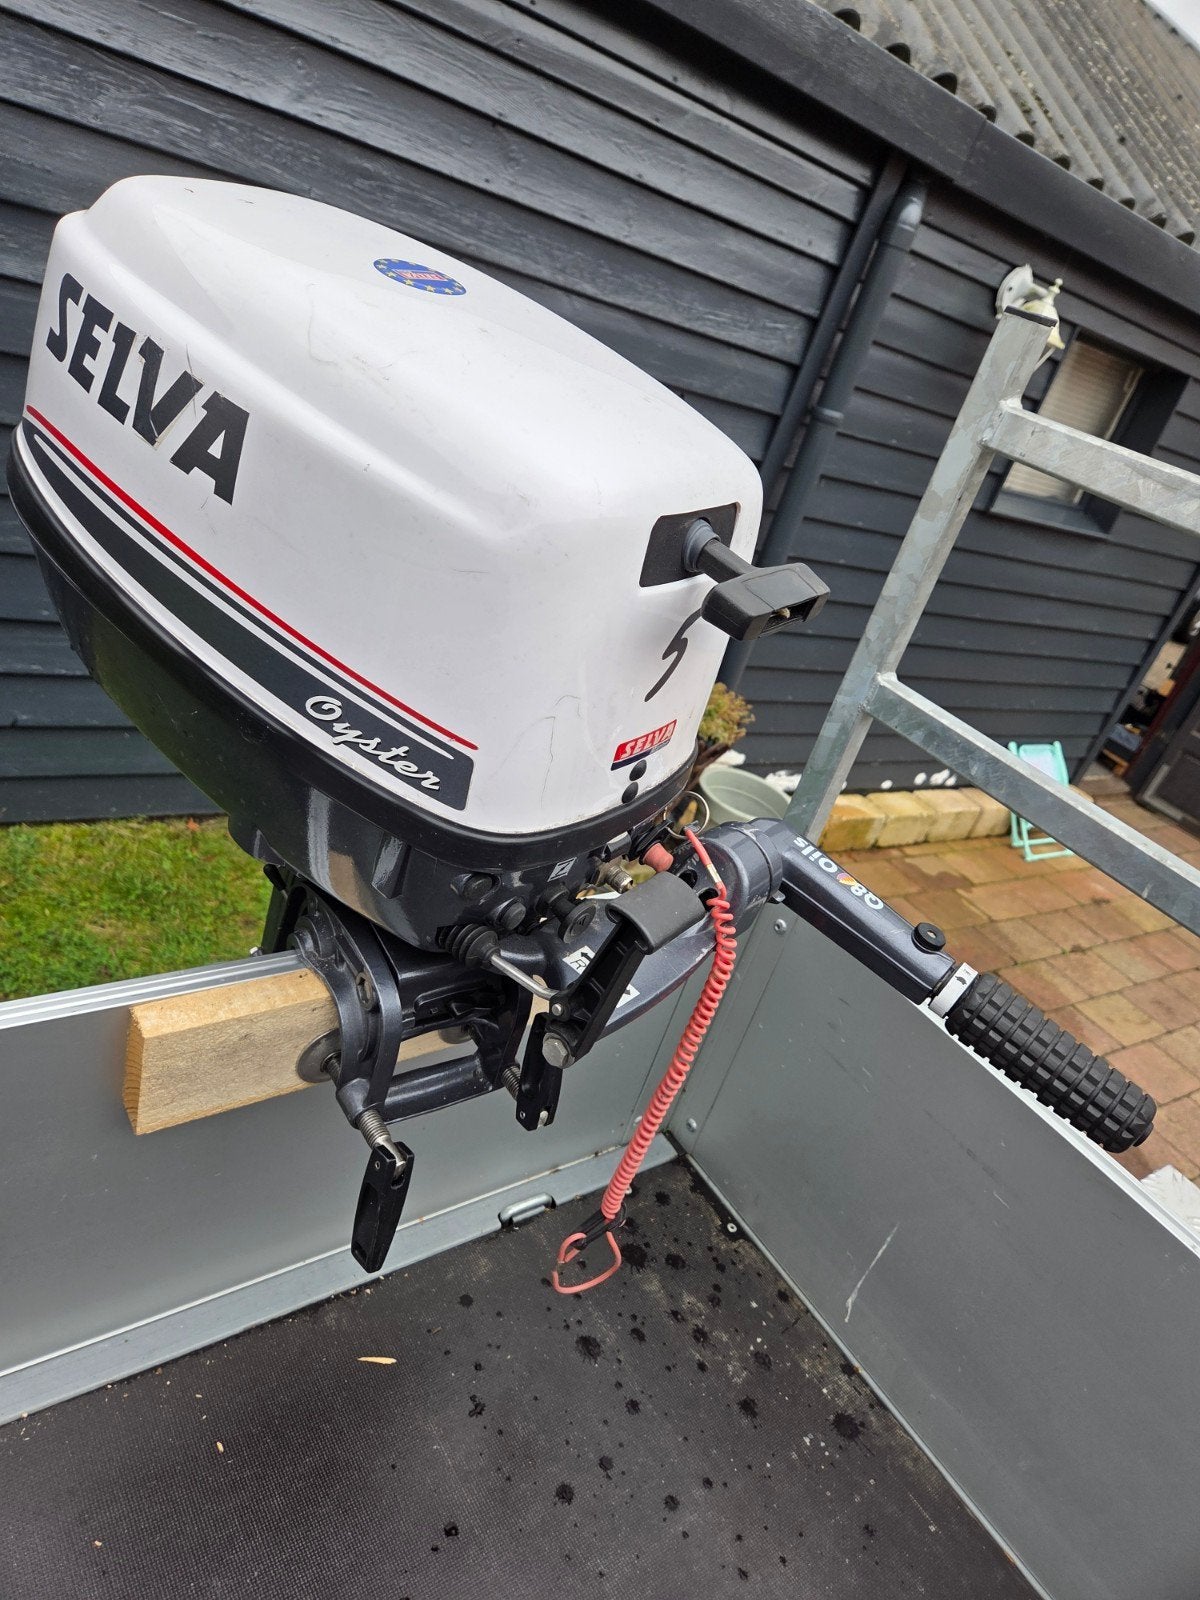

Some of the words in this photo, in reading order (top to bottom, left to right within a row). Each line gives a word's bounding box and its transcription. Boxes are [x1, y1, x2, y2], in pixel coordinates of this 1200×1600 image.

[46, 273, 250, 505] SELVA
[305, 695, 441, 791] Oyster
[621, 723, 675, 758] SELVA
[793, 836, 838, 873] Oils
[850, 883, 884, 910] Q8
